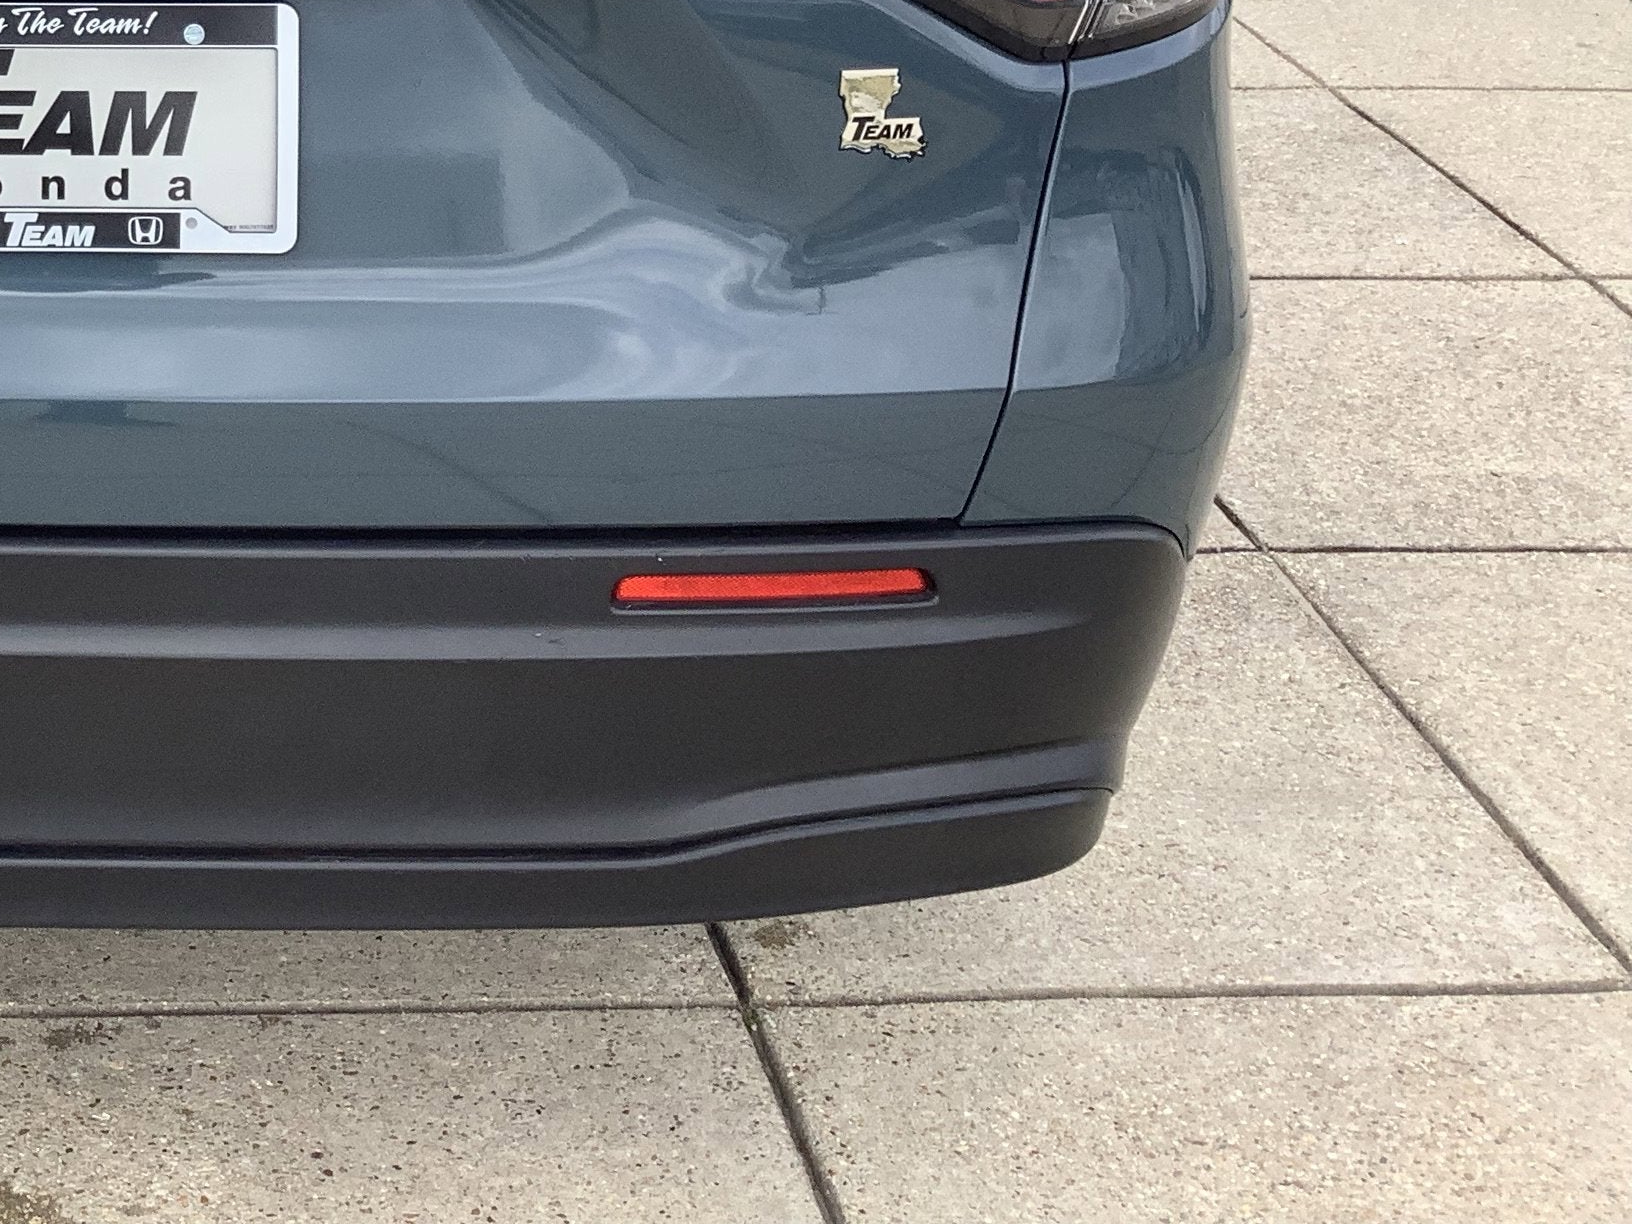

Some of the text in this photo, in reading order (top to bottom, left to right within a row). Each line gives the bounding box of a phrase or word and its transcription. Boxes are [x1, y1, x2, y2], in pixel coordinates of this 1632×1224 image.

[11, 7, 64, 36] The
[67, 7, 159, 36] Team!
[852, 116, 914, 142] TEAM
[4, 213, 96, 247] TEAM
